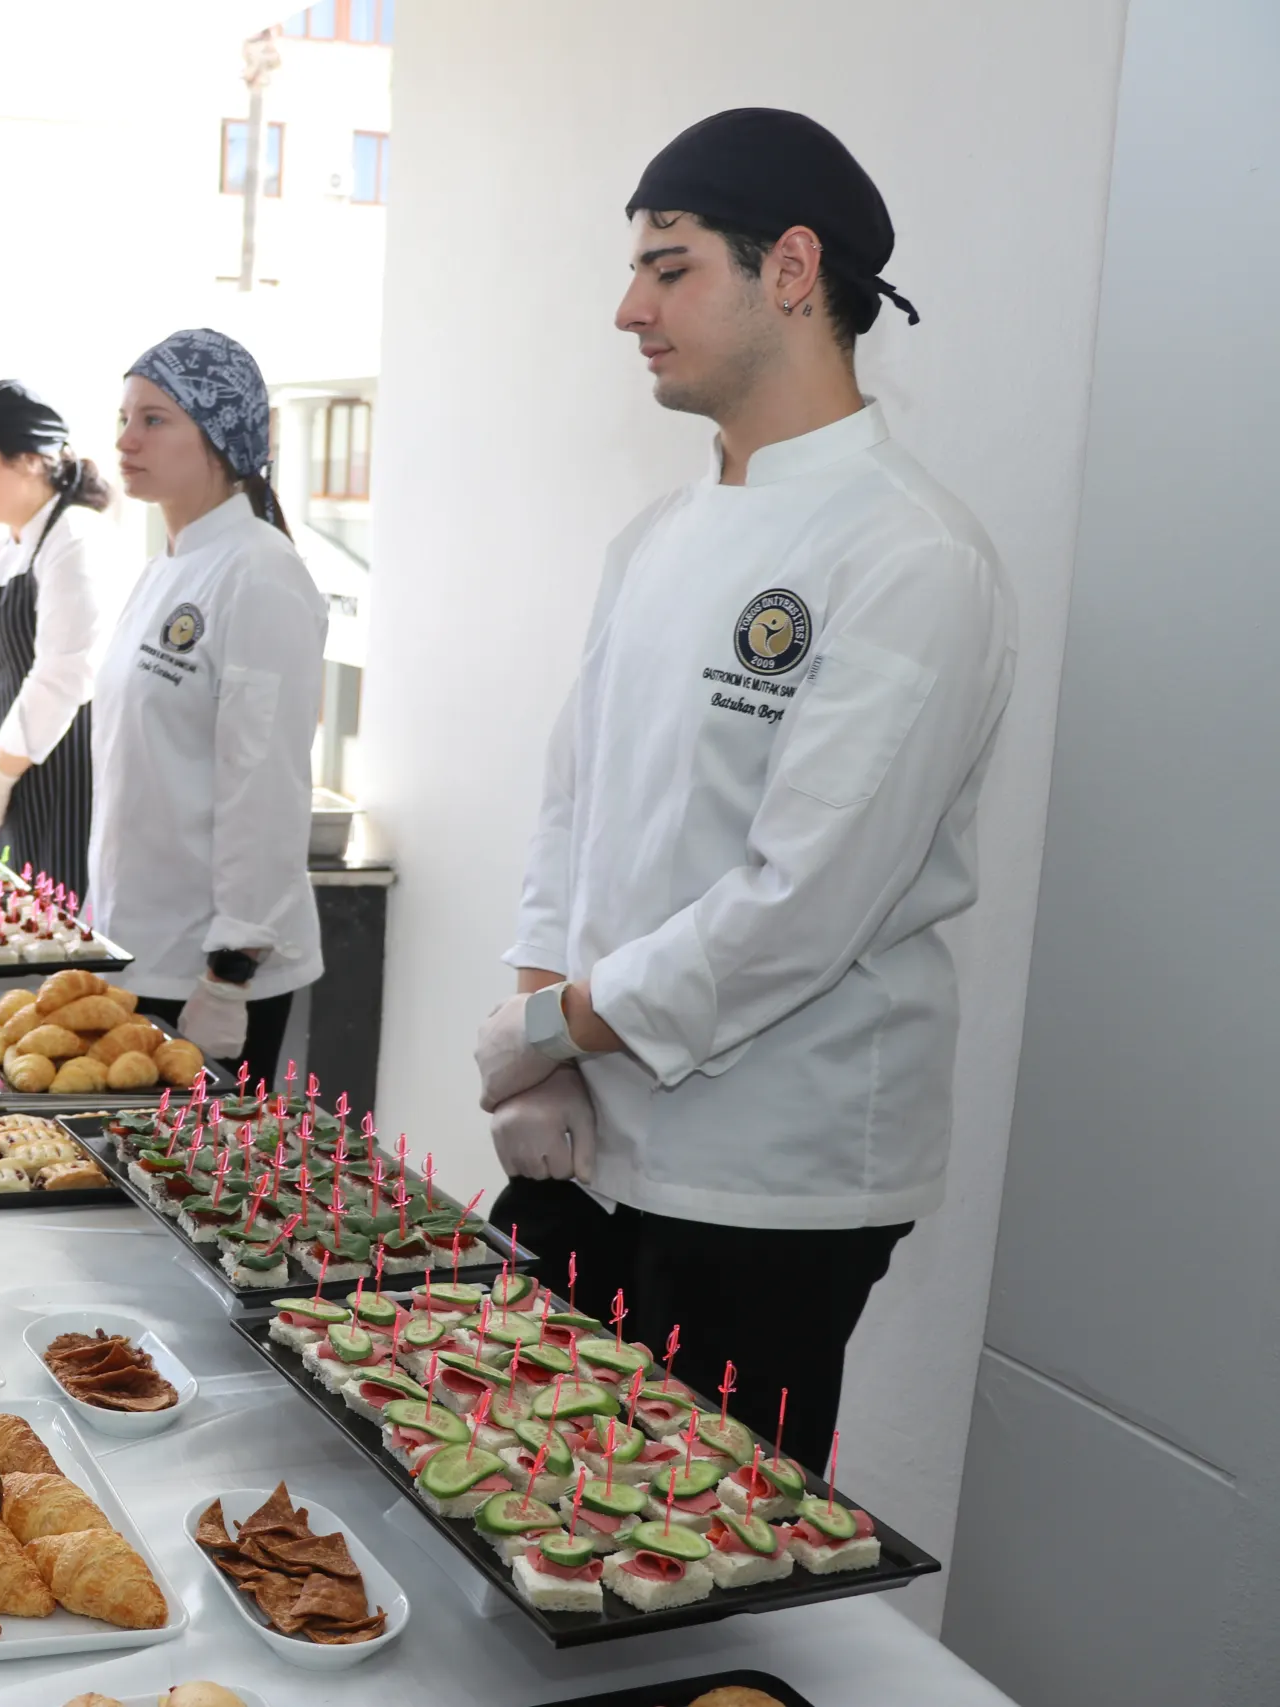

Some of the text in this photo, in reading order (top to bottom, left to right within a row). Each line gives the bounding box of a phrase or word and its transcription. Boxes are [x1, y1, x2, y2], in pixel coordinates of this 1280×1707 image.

[740, 602, 762, 632] TOROS
[751, 655, 775, 669] 2009
[743, 676, 752, 689] VE
[752, 679, 780, 696] MUTFAK
[711, 692, 756, 716] Batuhan
